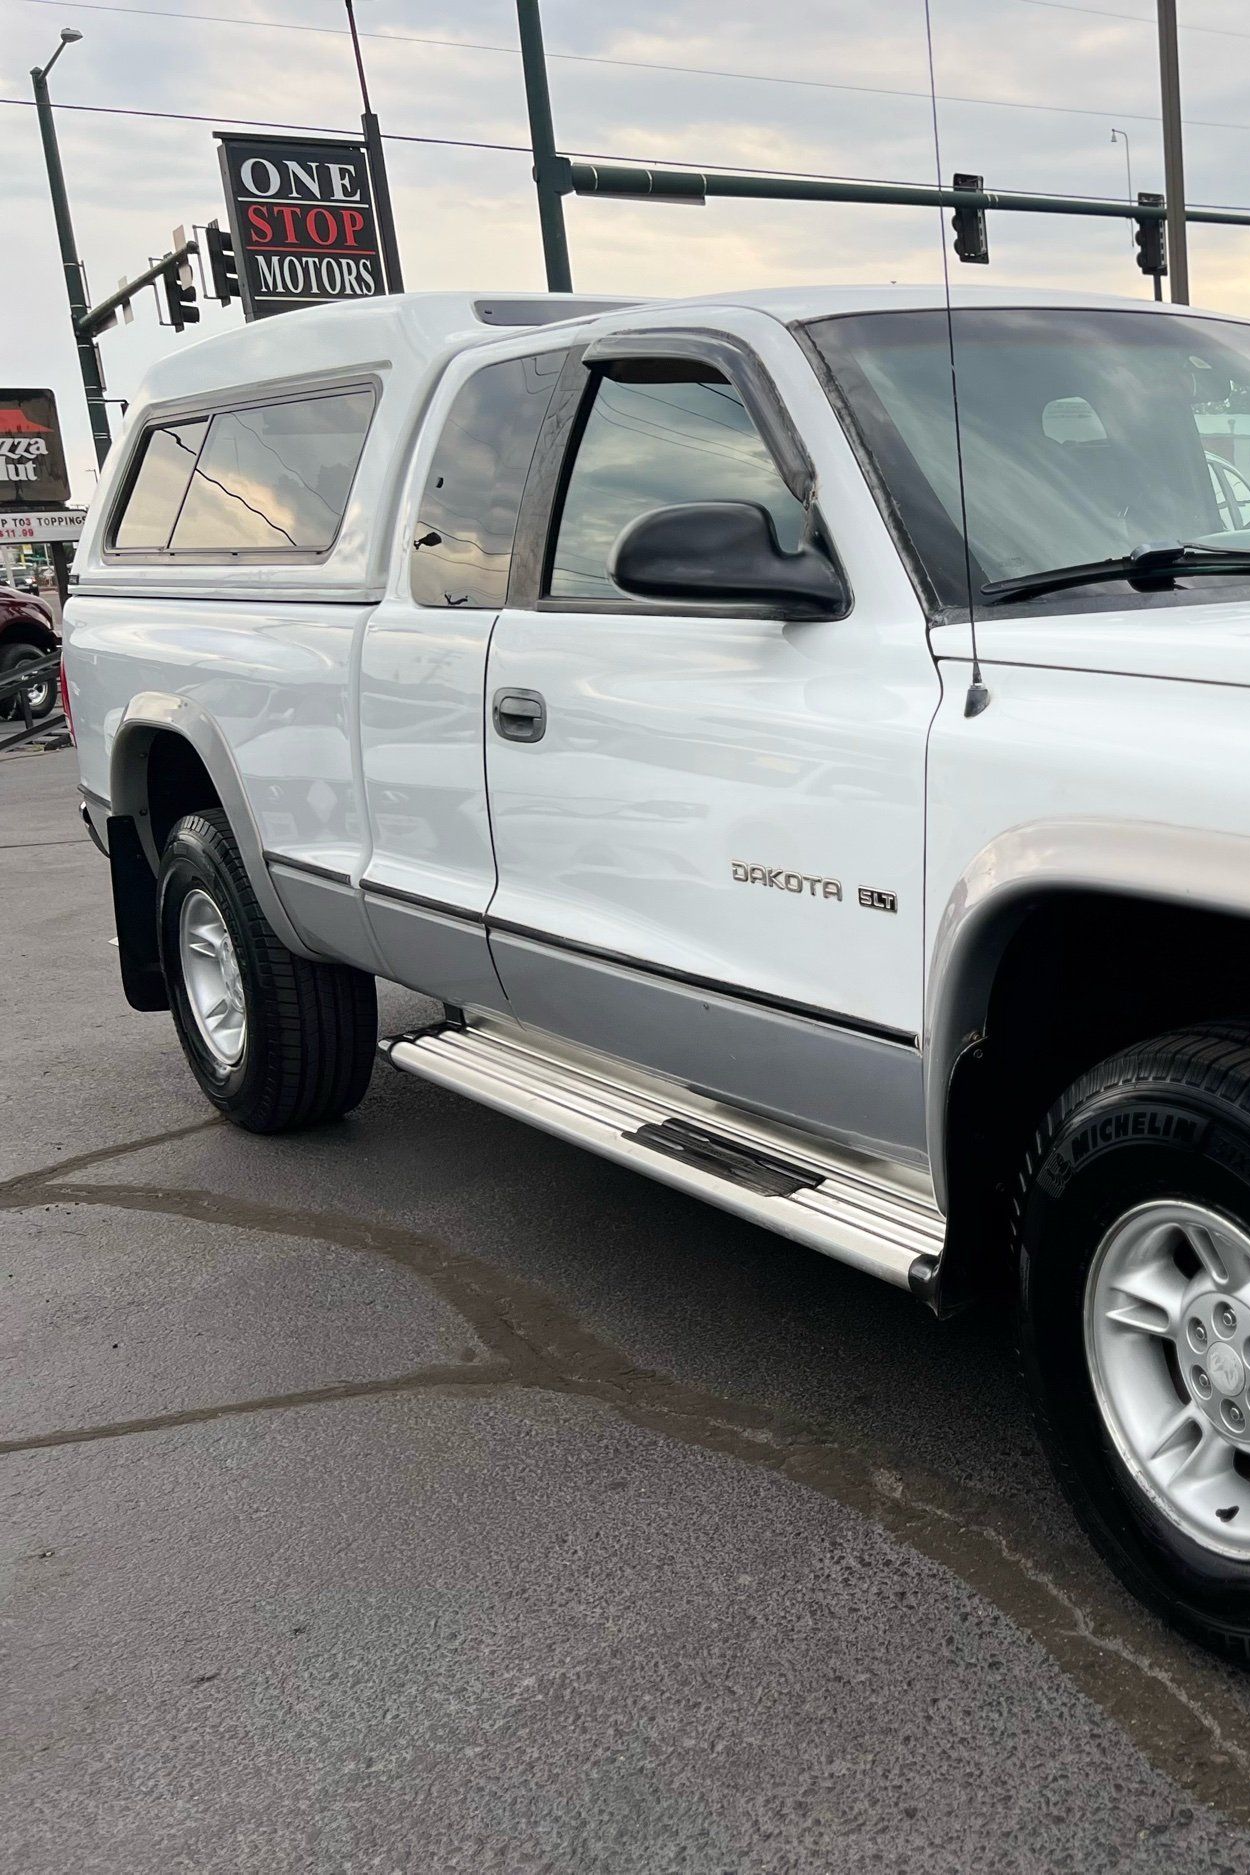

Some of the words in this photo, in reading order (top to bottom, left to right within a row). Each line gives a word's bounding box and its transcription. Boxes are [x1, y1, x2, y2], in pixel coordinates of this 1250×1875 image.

[240, 157, 361, 202] ONE
[247, 204, 365, 247] STOP
[254, 254, 375, 296] MOTORS
[36, 515, 87, 526] TOPPINGS
[731, 859, 843, 902] DAKOTA
[858, 888, 896, 910] SLT
[1072, 1111, 1198, 1159] MICHELIN
